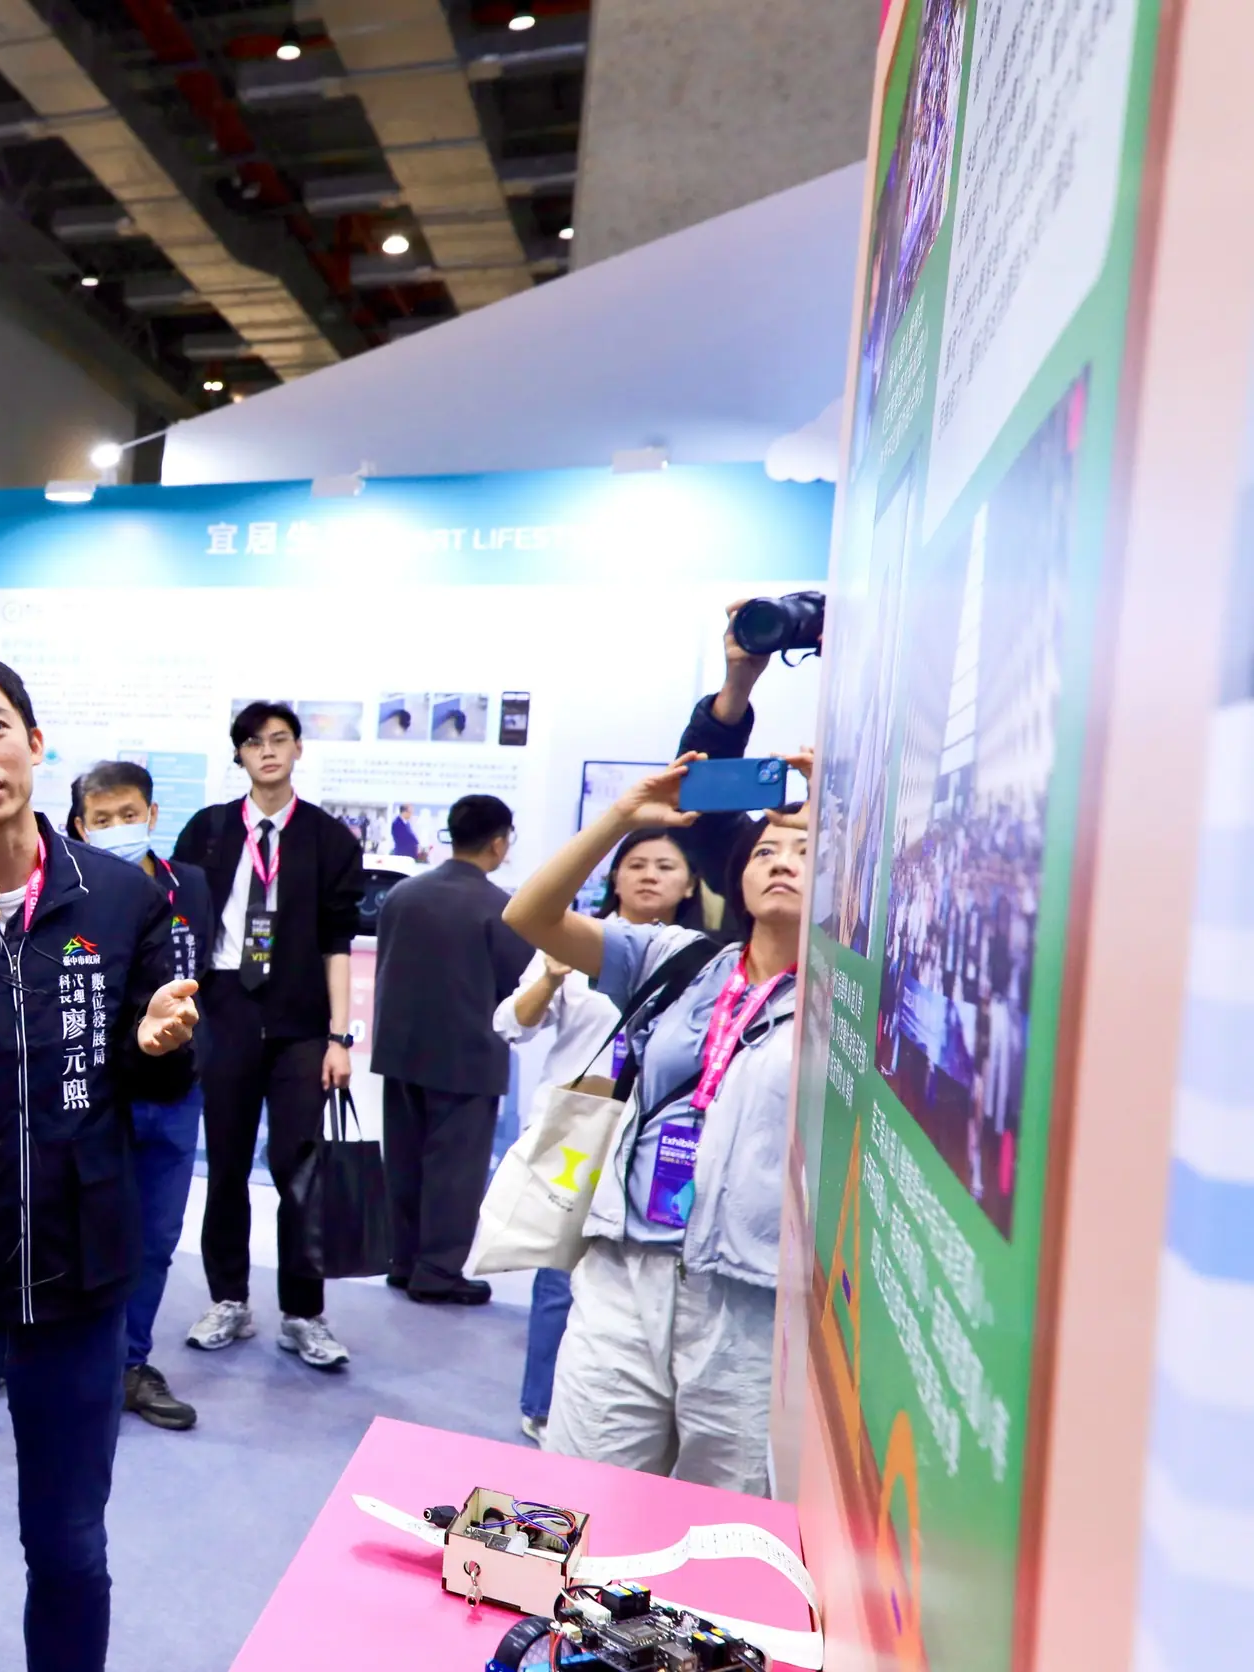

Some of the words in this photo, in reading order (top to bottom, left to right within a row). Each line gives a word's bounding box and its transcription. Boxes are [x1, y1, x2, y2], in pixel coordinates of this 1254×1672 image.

[62, 953, 102, 966] 臺中市政府
[251, 952, 271, 962] VIP
[58, 973, 73, 1005] 科長
[72, 972, 87, 1005] 代理
[90, 971, 107, 1067] 數位發展局
[61, 1007, 91, 1111] 廖元熙
